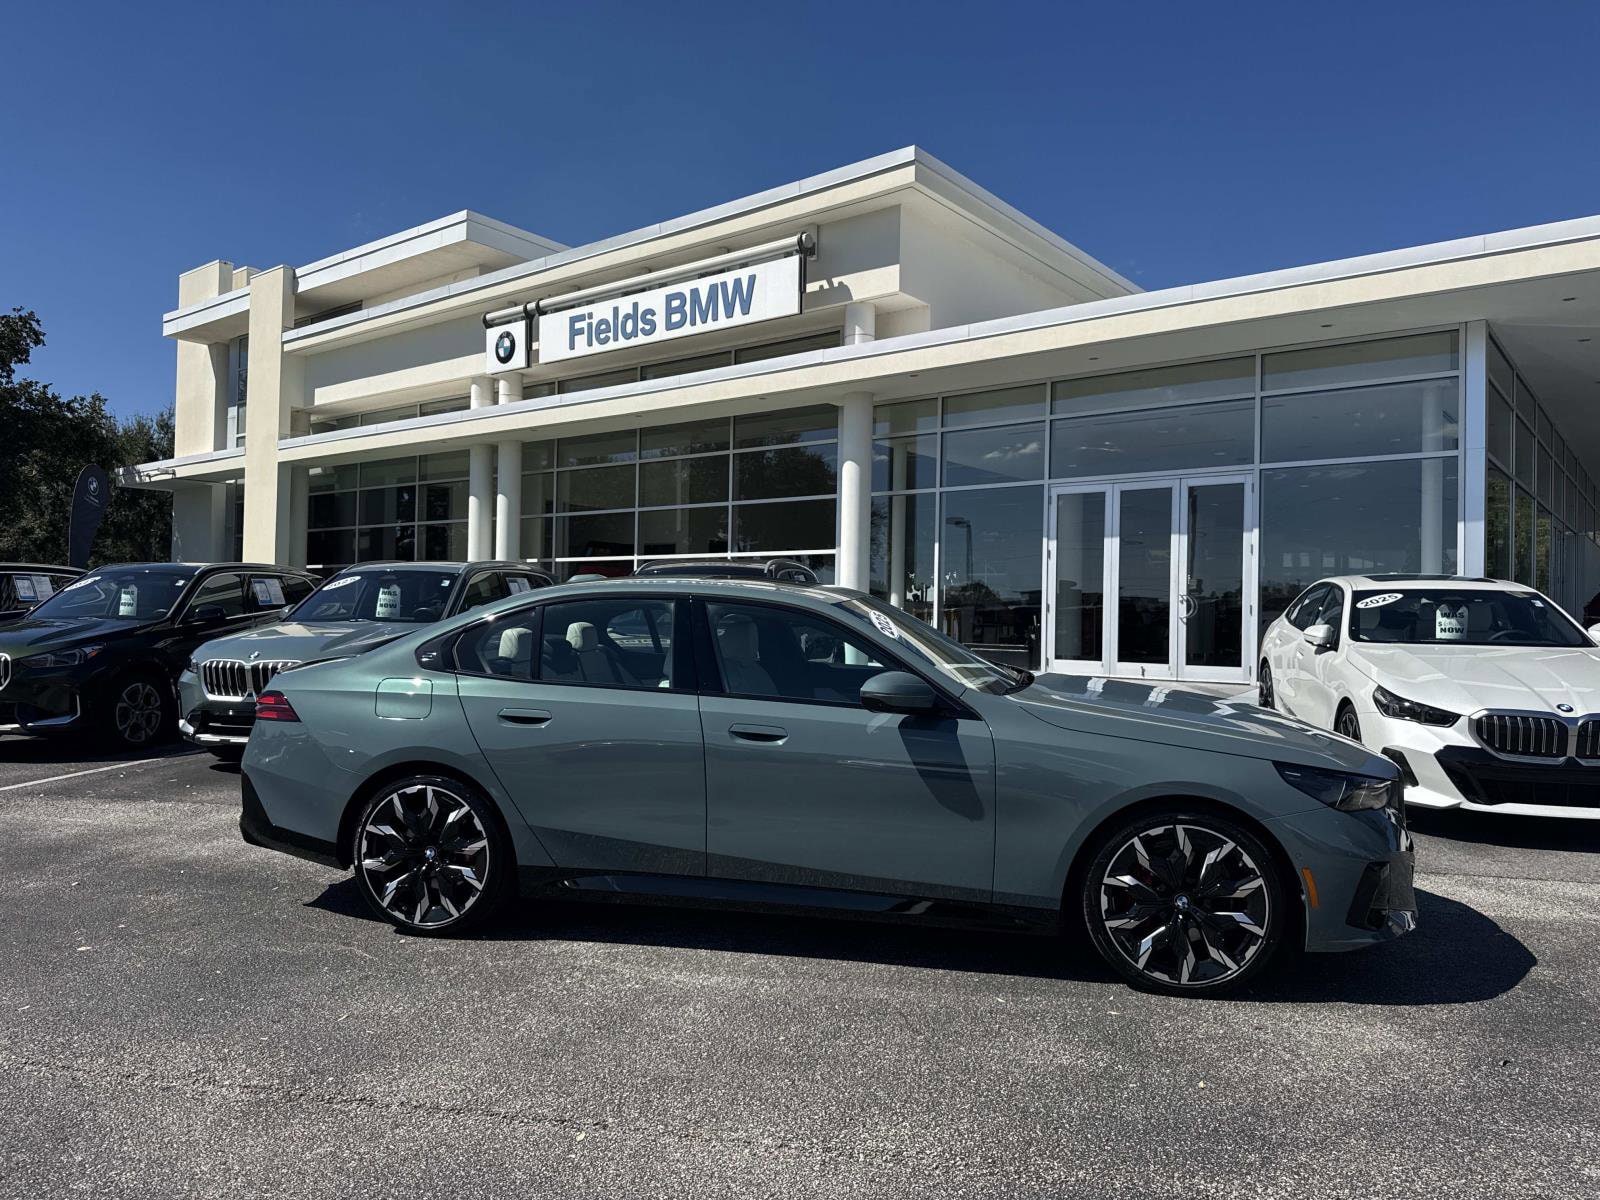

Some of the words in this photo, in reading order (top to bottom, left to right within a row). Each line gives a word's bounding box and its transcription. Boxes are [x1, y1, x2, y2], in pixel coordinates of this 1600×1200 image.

[568, 302, 657, 350] Fields
[665, 274, 756, 331] BMW
[1361, 594, 1399, 607] 2025
[872, 611, 895, 636] 2025
